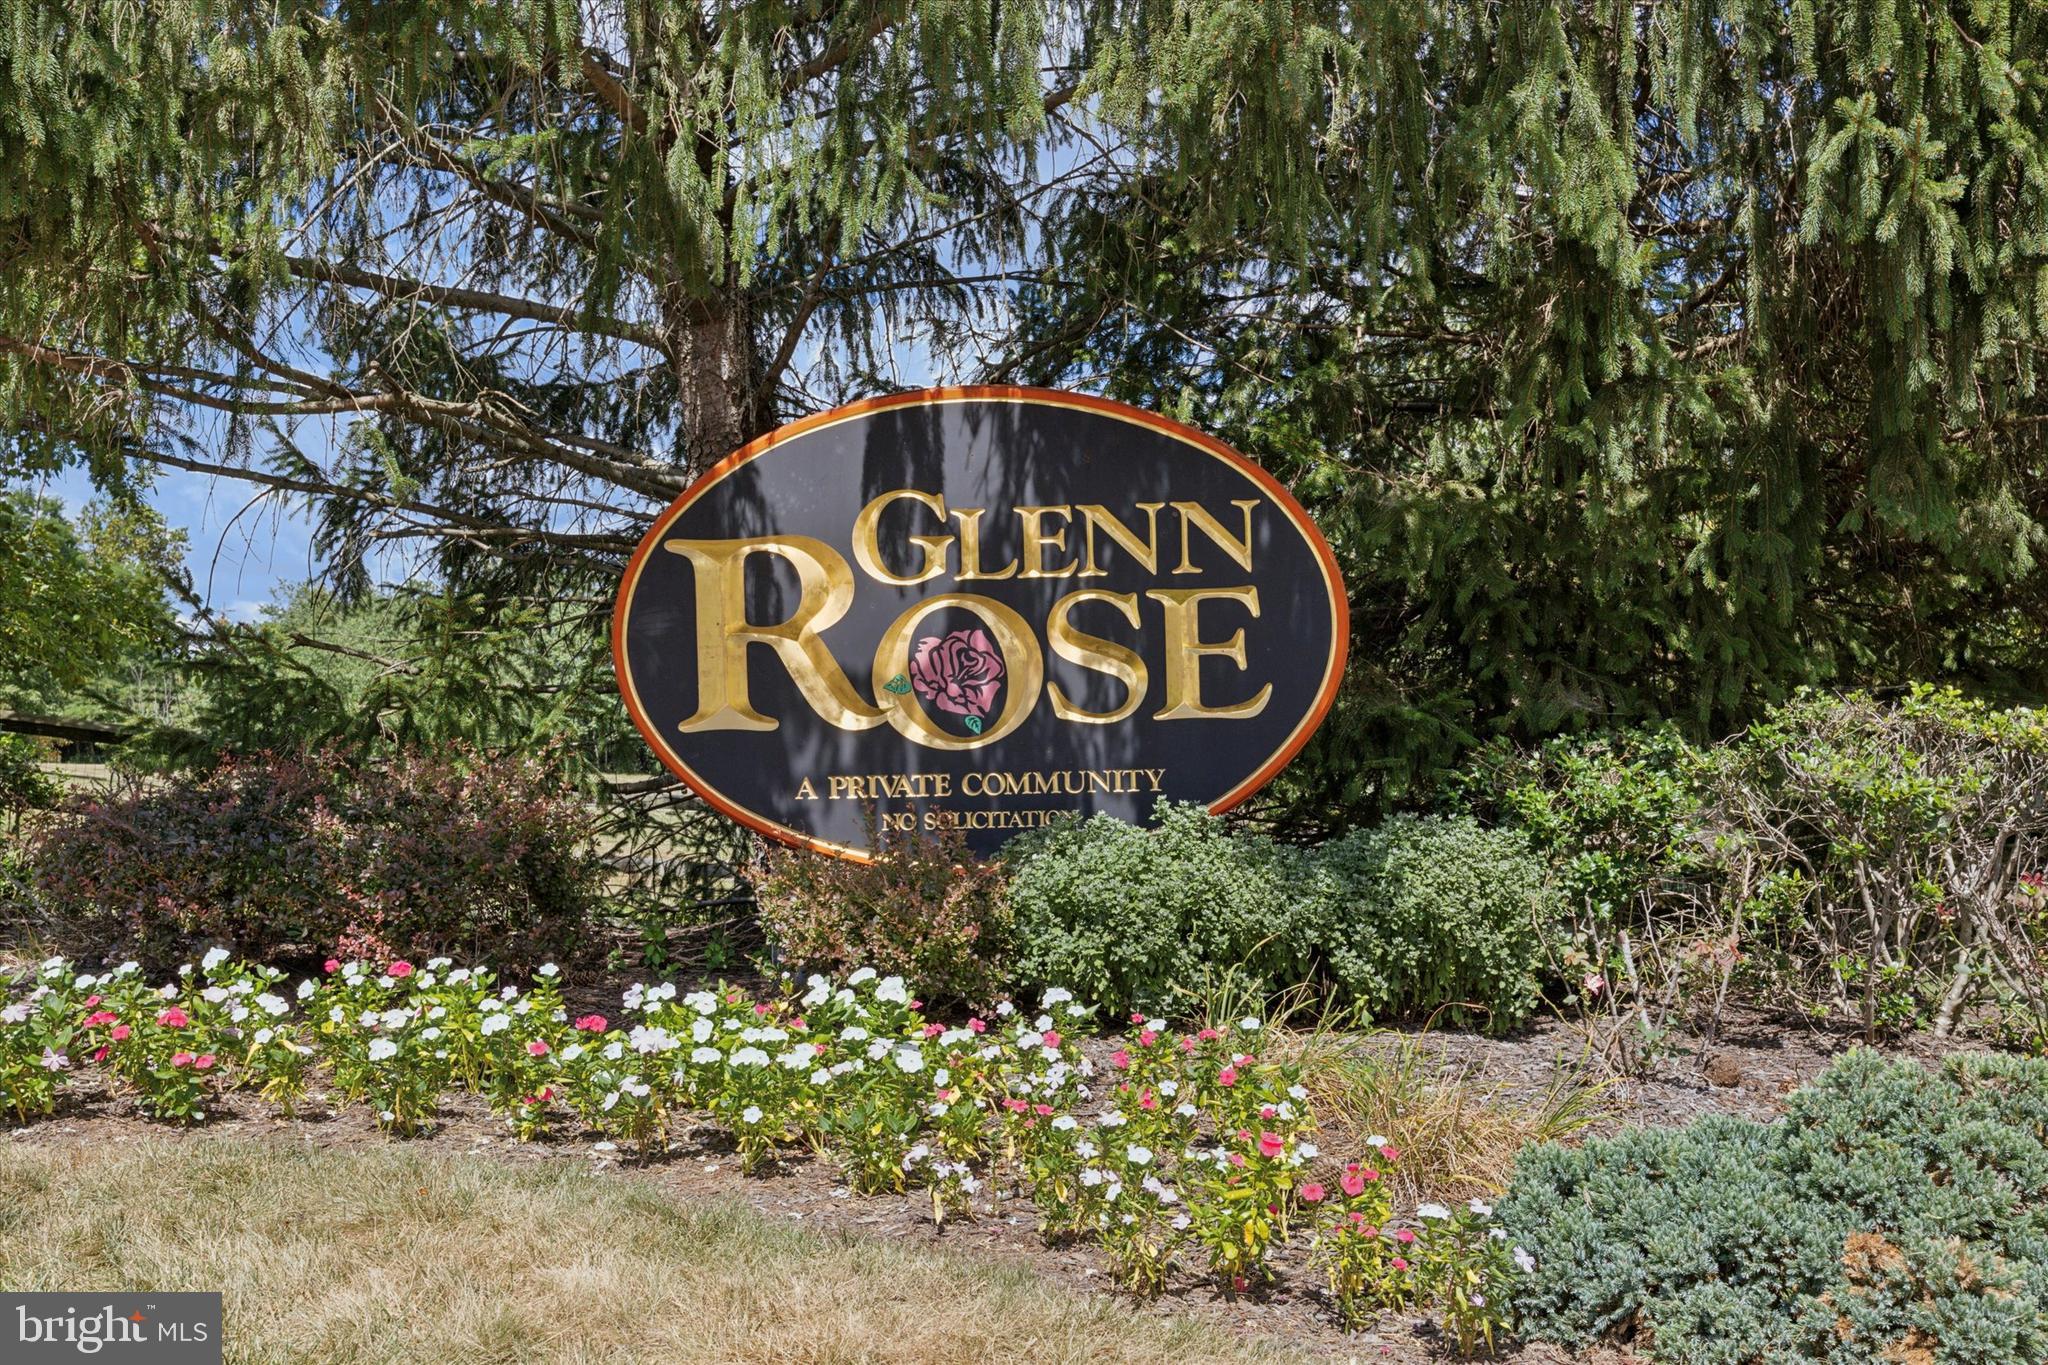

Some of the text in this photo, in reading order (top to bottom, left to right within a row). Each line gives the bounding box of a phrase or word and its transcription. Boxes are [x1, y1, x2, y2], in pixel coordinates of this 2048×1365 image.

[851, 488, 1261, 587] GLENN
[663, 534, 1273, 751] ROSE
[795, 768, 1166, 800] A PRIVATE COMMUNITY
[881, 809, 1077, 832] NO SOLICITATIO
